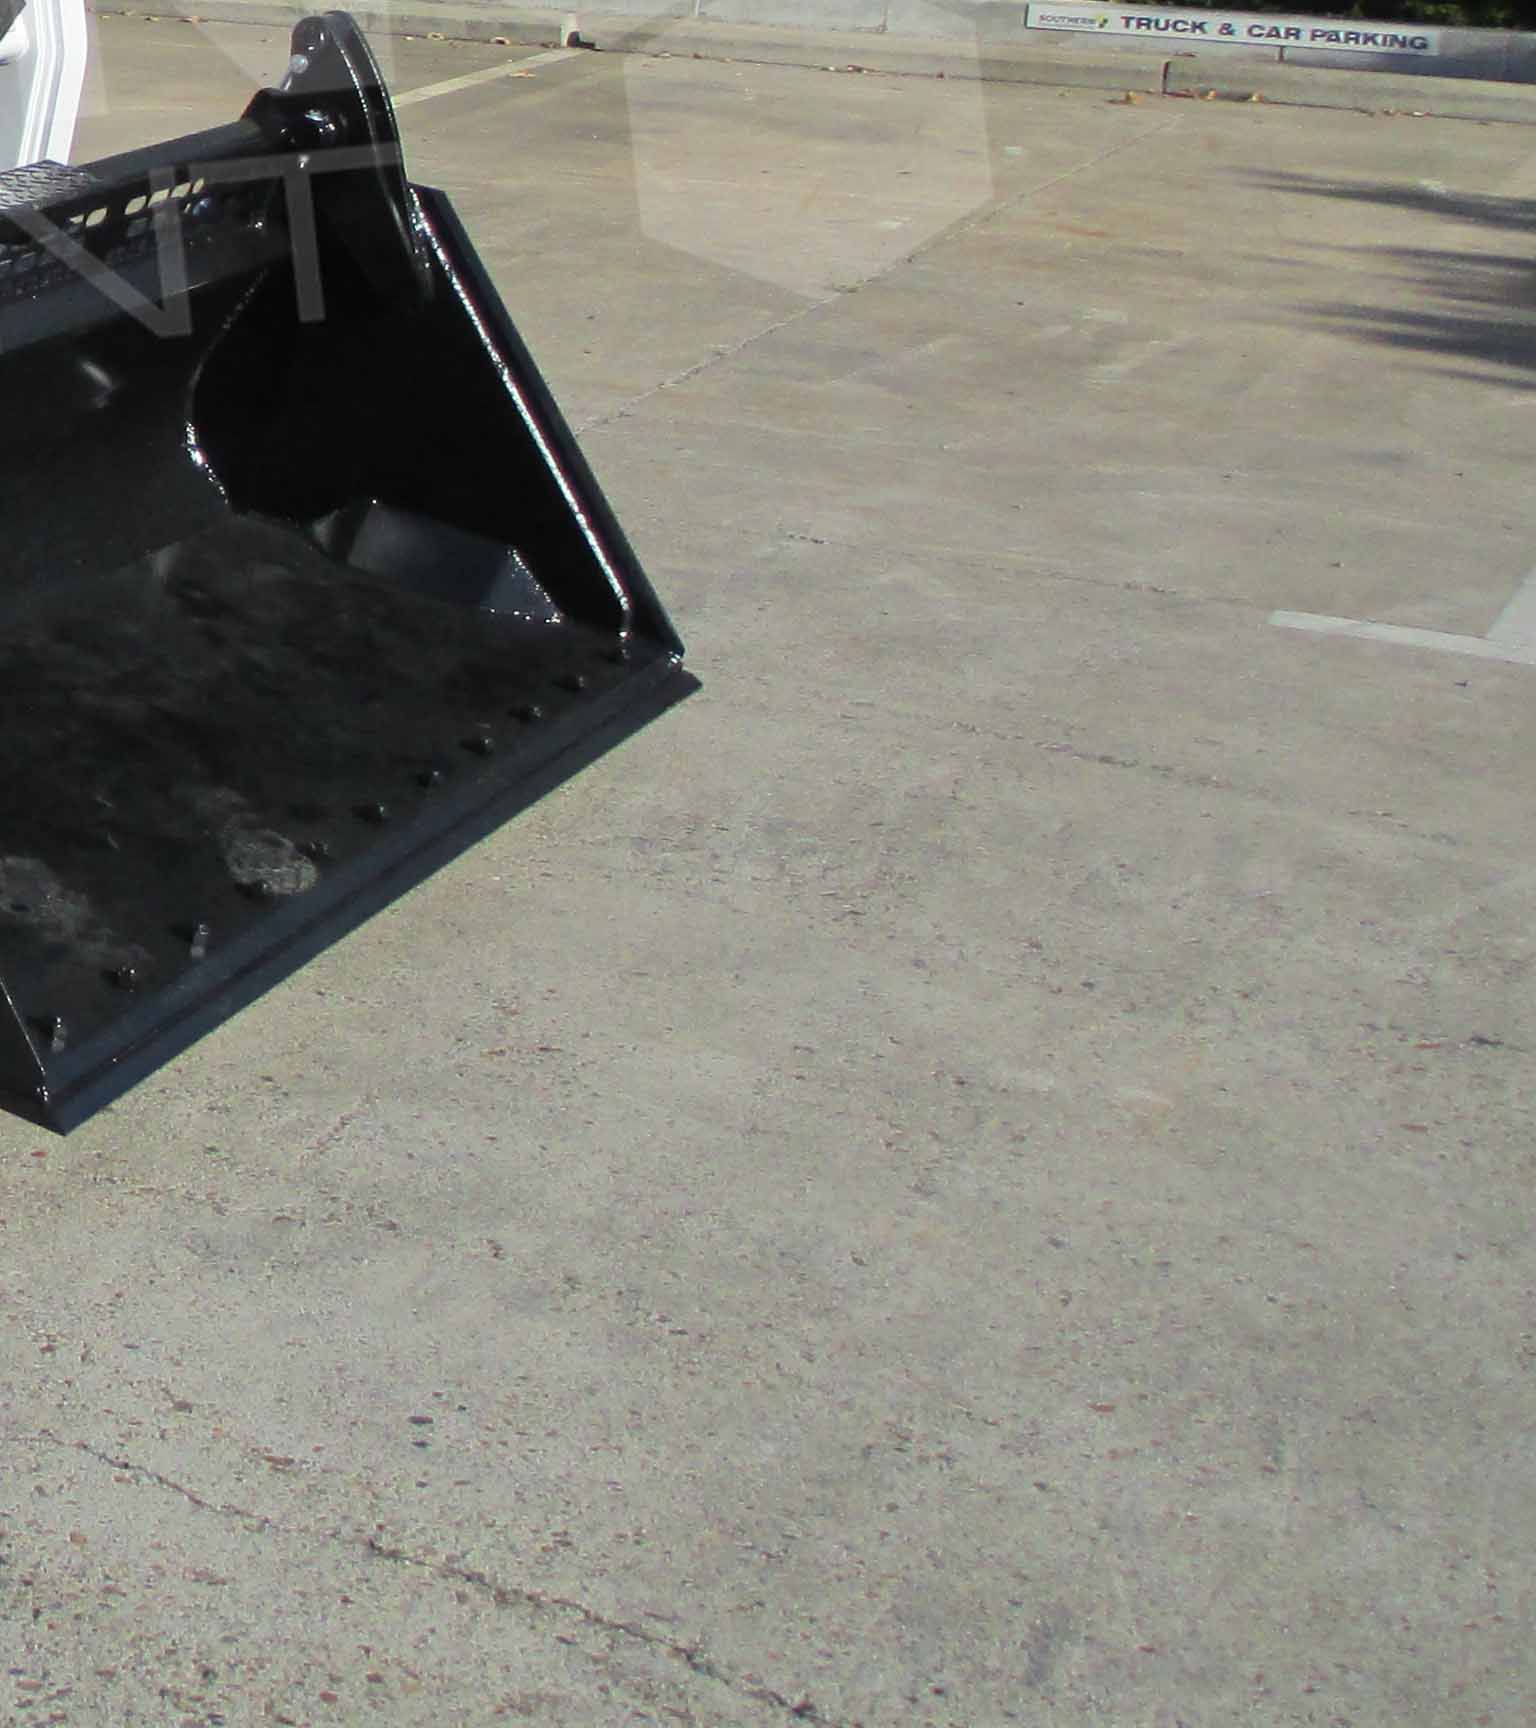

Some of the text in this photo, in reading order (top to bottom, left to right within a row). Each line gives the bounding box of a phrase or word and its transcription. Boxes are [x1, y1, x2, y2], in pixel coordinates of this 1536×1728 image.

[1120, 14, 1428, 51] TRUCK & CAR PARKING
